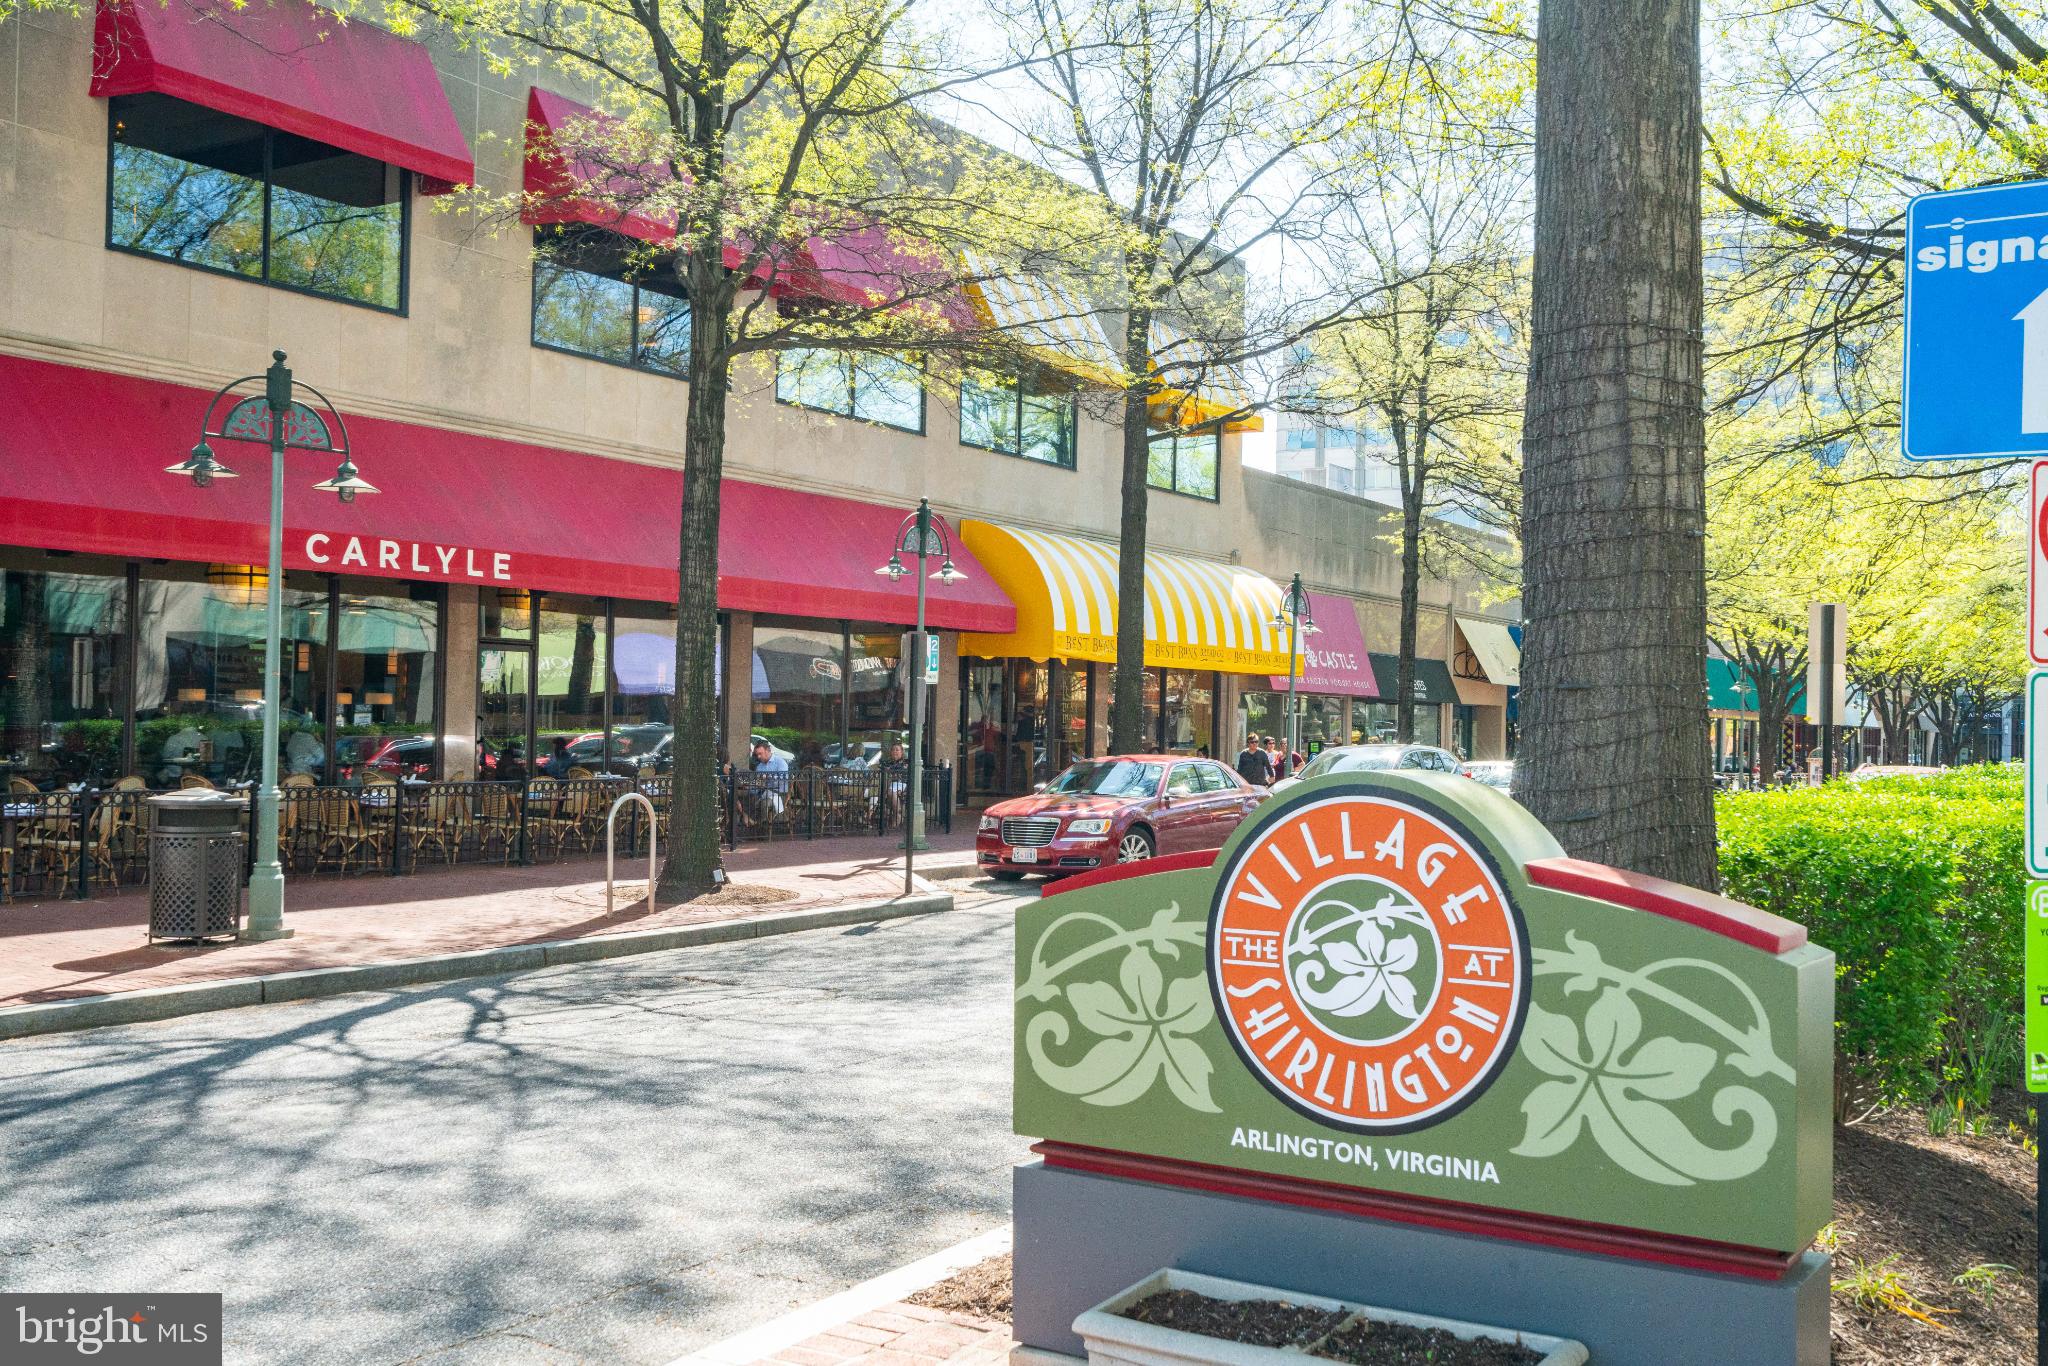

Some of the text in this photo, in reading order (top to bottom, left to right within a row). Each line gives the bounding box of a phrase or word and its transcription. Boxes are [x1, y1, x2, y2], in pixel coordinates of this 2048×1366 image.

[305, 533, 511, 580] CARLYLE
[1318, 650, 1358, 671] CASTLE
[1237, 811, 1489, 926] VILLAGE
[1225, 936, 1278, 960] THE
[1464, 953, 1504, 977] AT
[1227, 977, 1500, 1112] SHIRLINGTON
[1231, 1127, 1500, 1184] ARLINGTON, VIRGINIA
